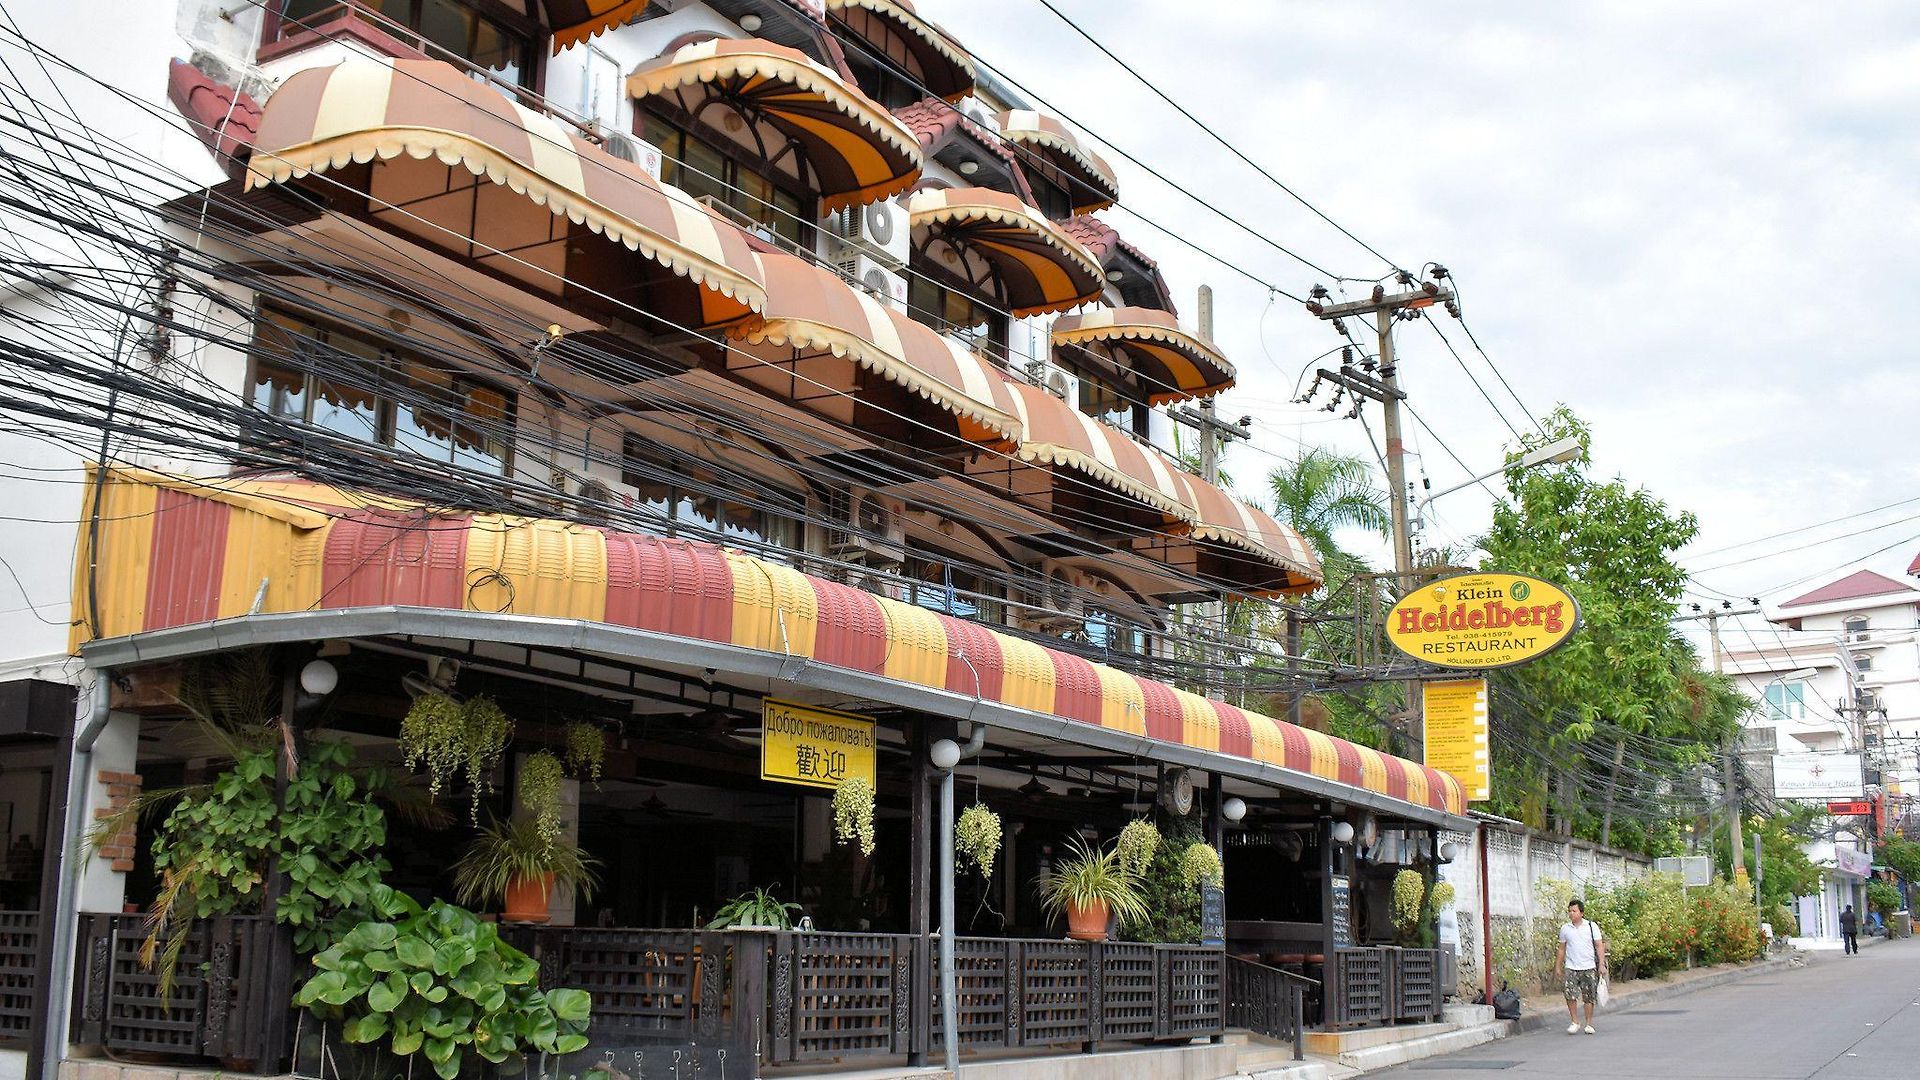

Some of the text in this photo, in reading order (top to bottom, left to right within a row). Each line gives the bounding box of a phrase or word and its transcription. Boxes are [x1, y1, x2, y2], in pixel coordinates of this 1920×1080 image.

[1457, 588, 1503, 601] Klein
[1397, 601, 1564, 634] Heidelberg
[1423, 637, 1537, 654] RESTAURANT
[767, 708, 873, 748] Добро пожаловать!
[796, 744, 846, 781] 歡迎
